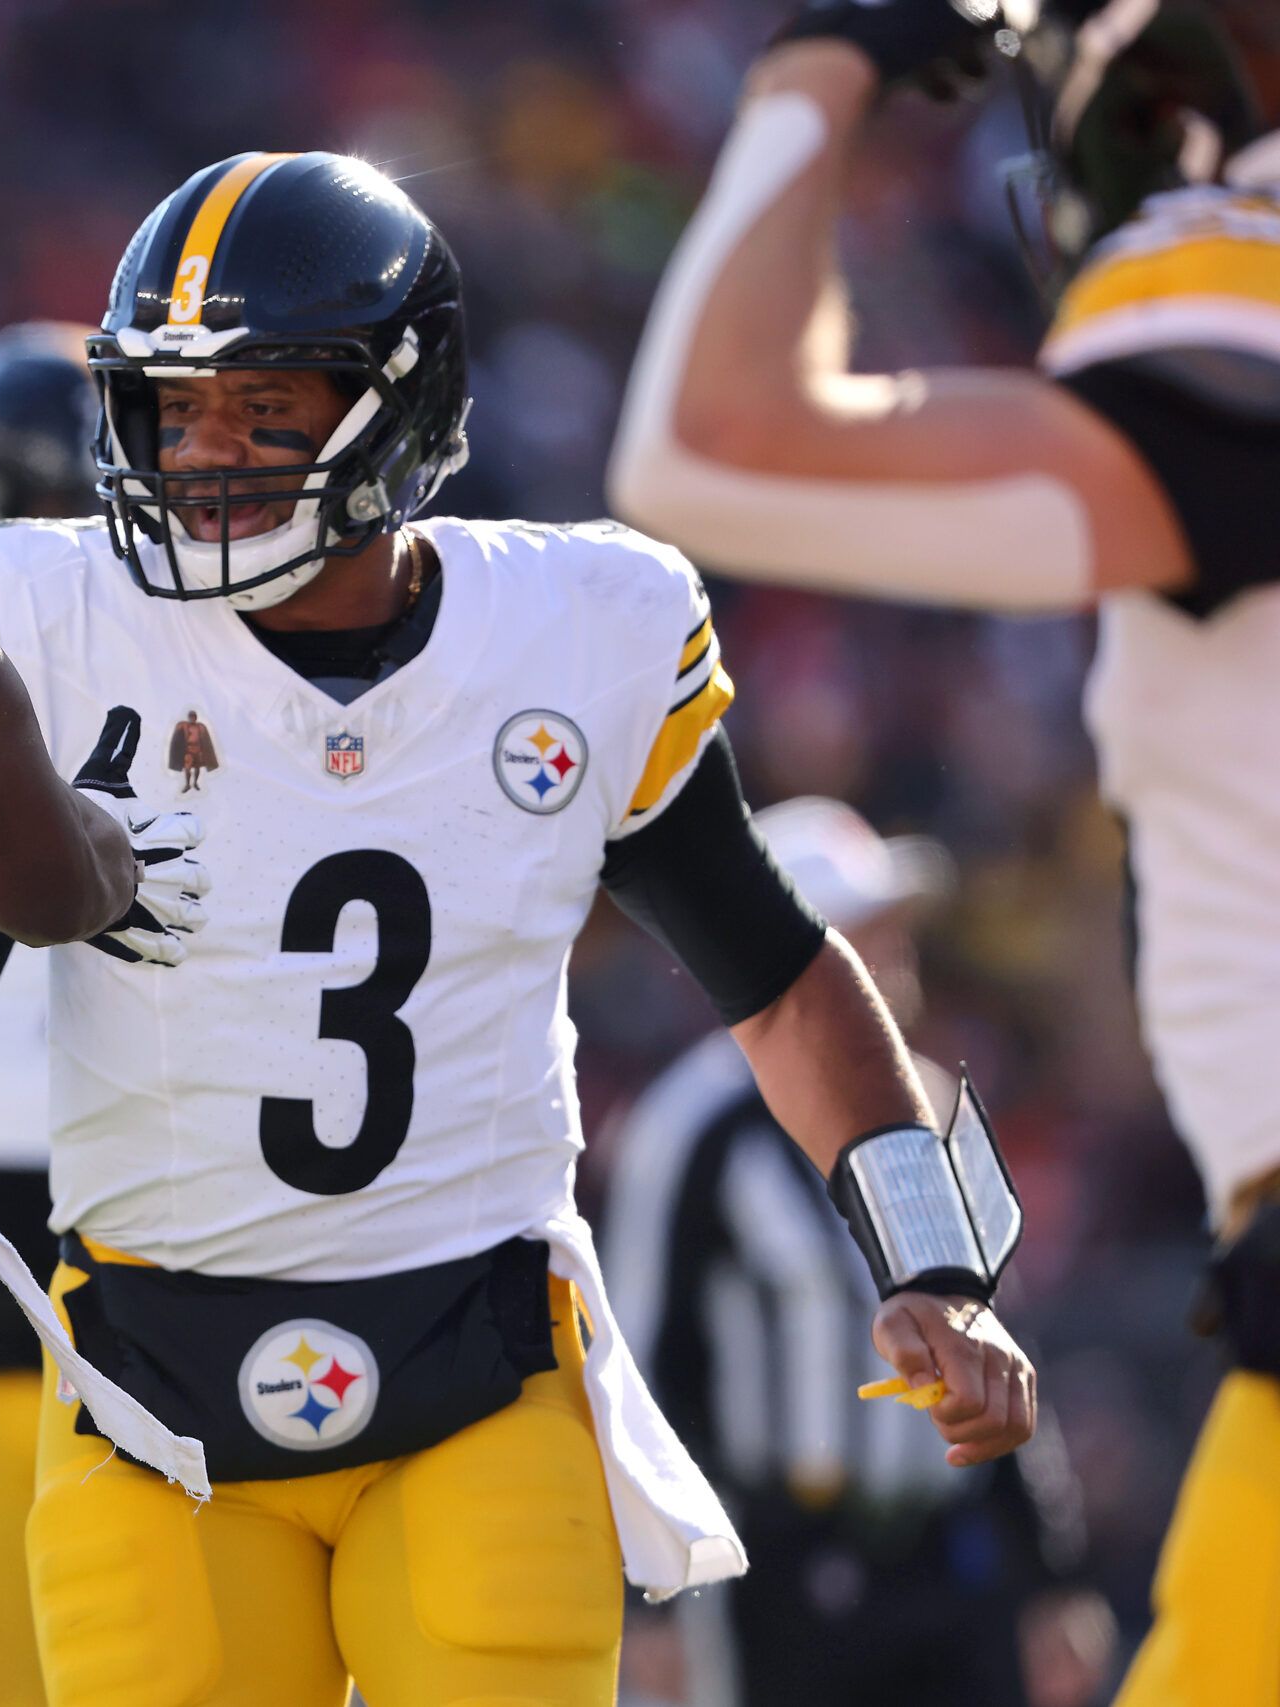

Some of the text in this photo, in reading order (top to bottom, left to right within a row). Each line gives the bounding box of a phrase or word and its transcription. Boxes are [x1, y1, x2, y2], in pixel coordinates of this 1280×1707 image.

[169, 255, 209, 322] 3
[330, 751, 362, 773] NFL
[504, 750, 540, 765] Steelers
[260, 848, 432, 1195] 3
[257, 1379, 302, 1395] Steelers
